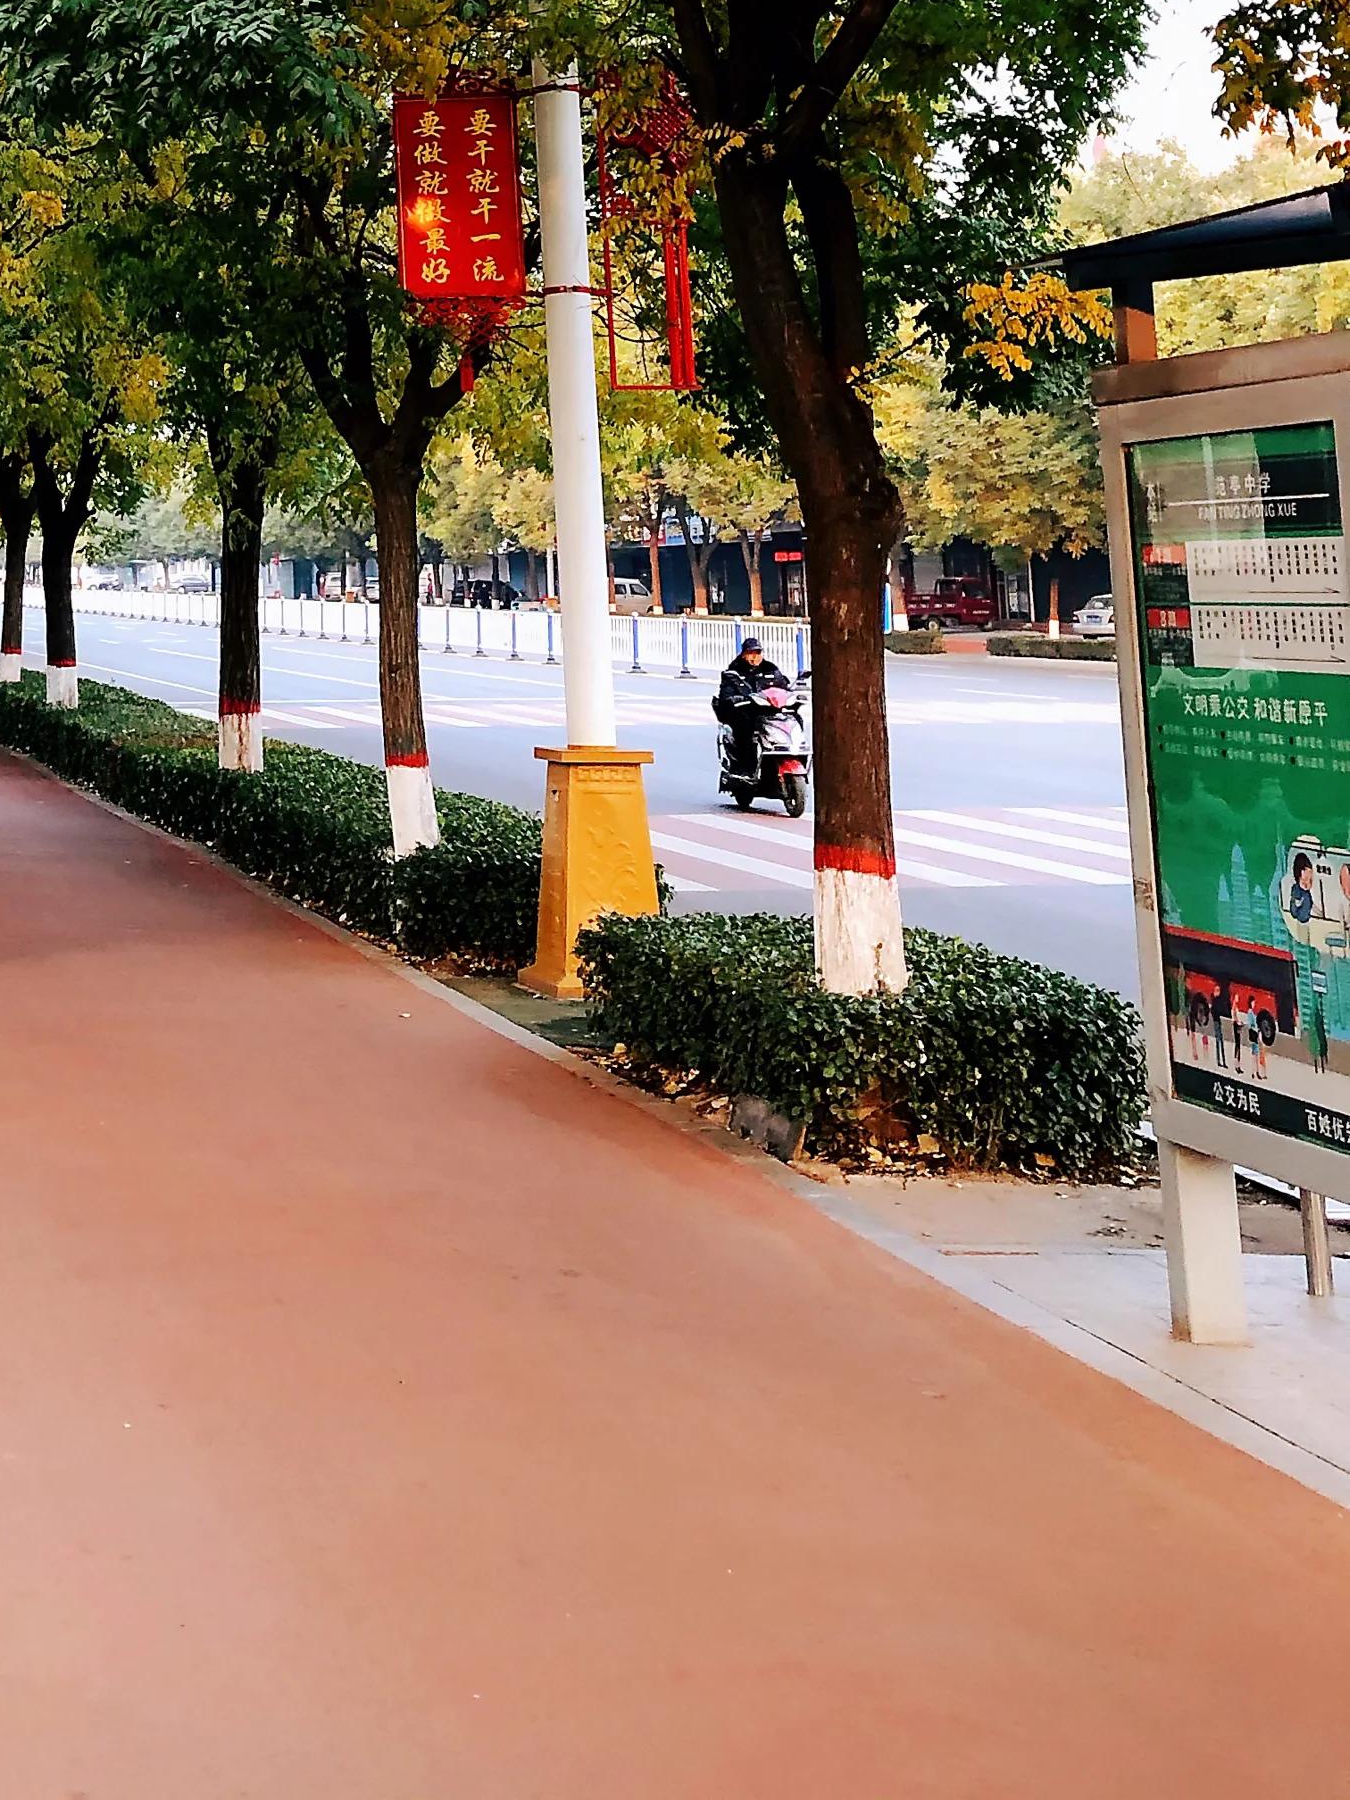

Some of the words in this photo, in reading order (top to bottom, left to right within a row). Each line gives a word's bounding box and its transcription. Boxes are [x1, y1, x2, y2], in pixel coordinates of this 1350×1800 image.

[413, 111, 451, 283] 要做就做最好
[464, 109, 504, 281] 要干就干一流
[1277, 502, 1298, 517] XUE
[1213, 1081, 1261, 1116] 公交为民
